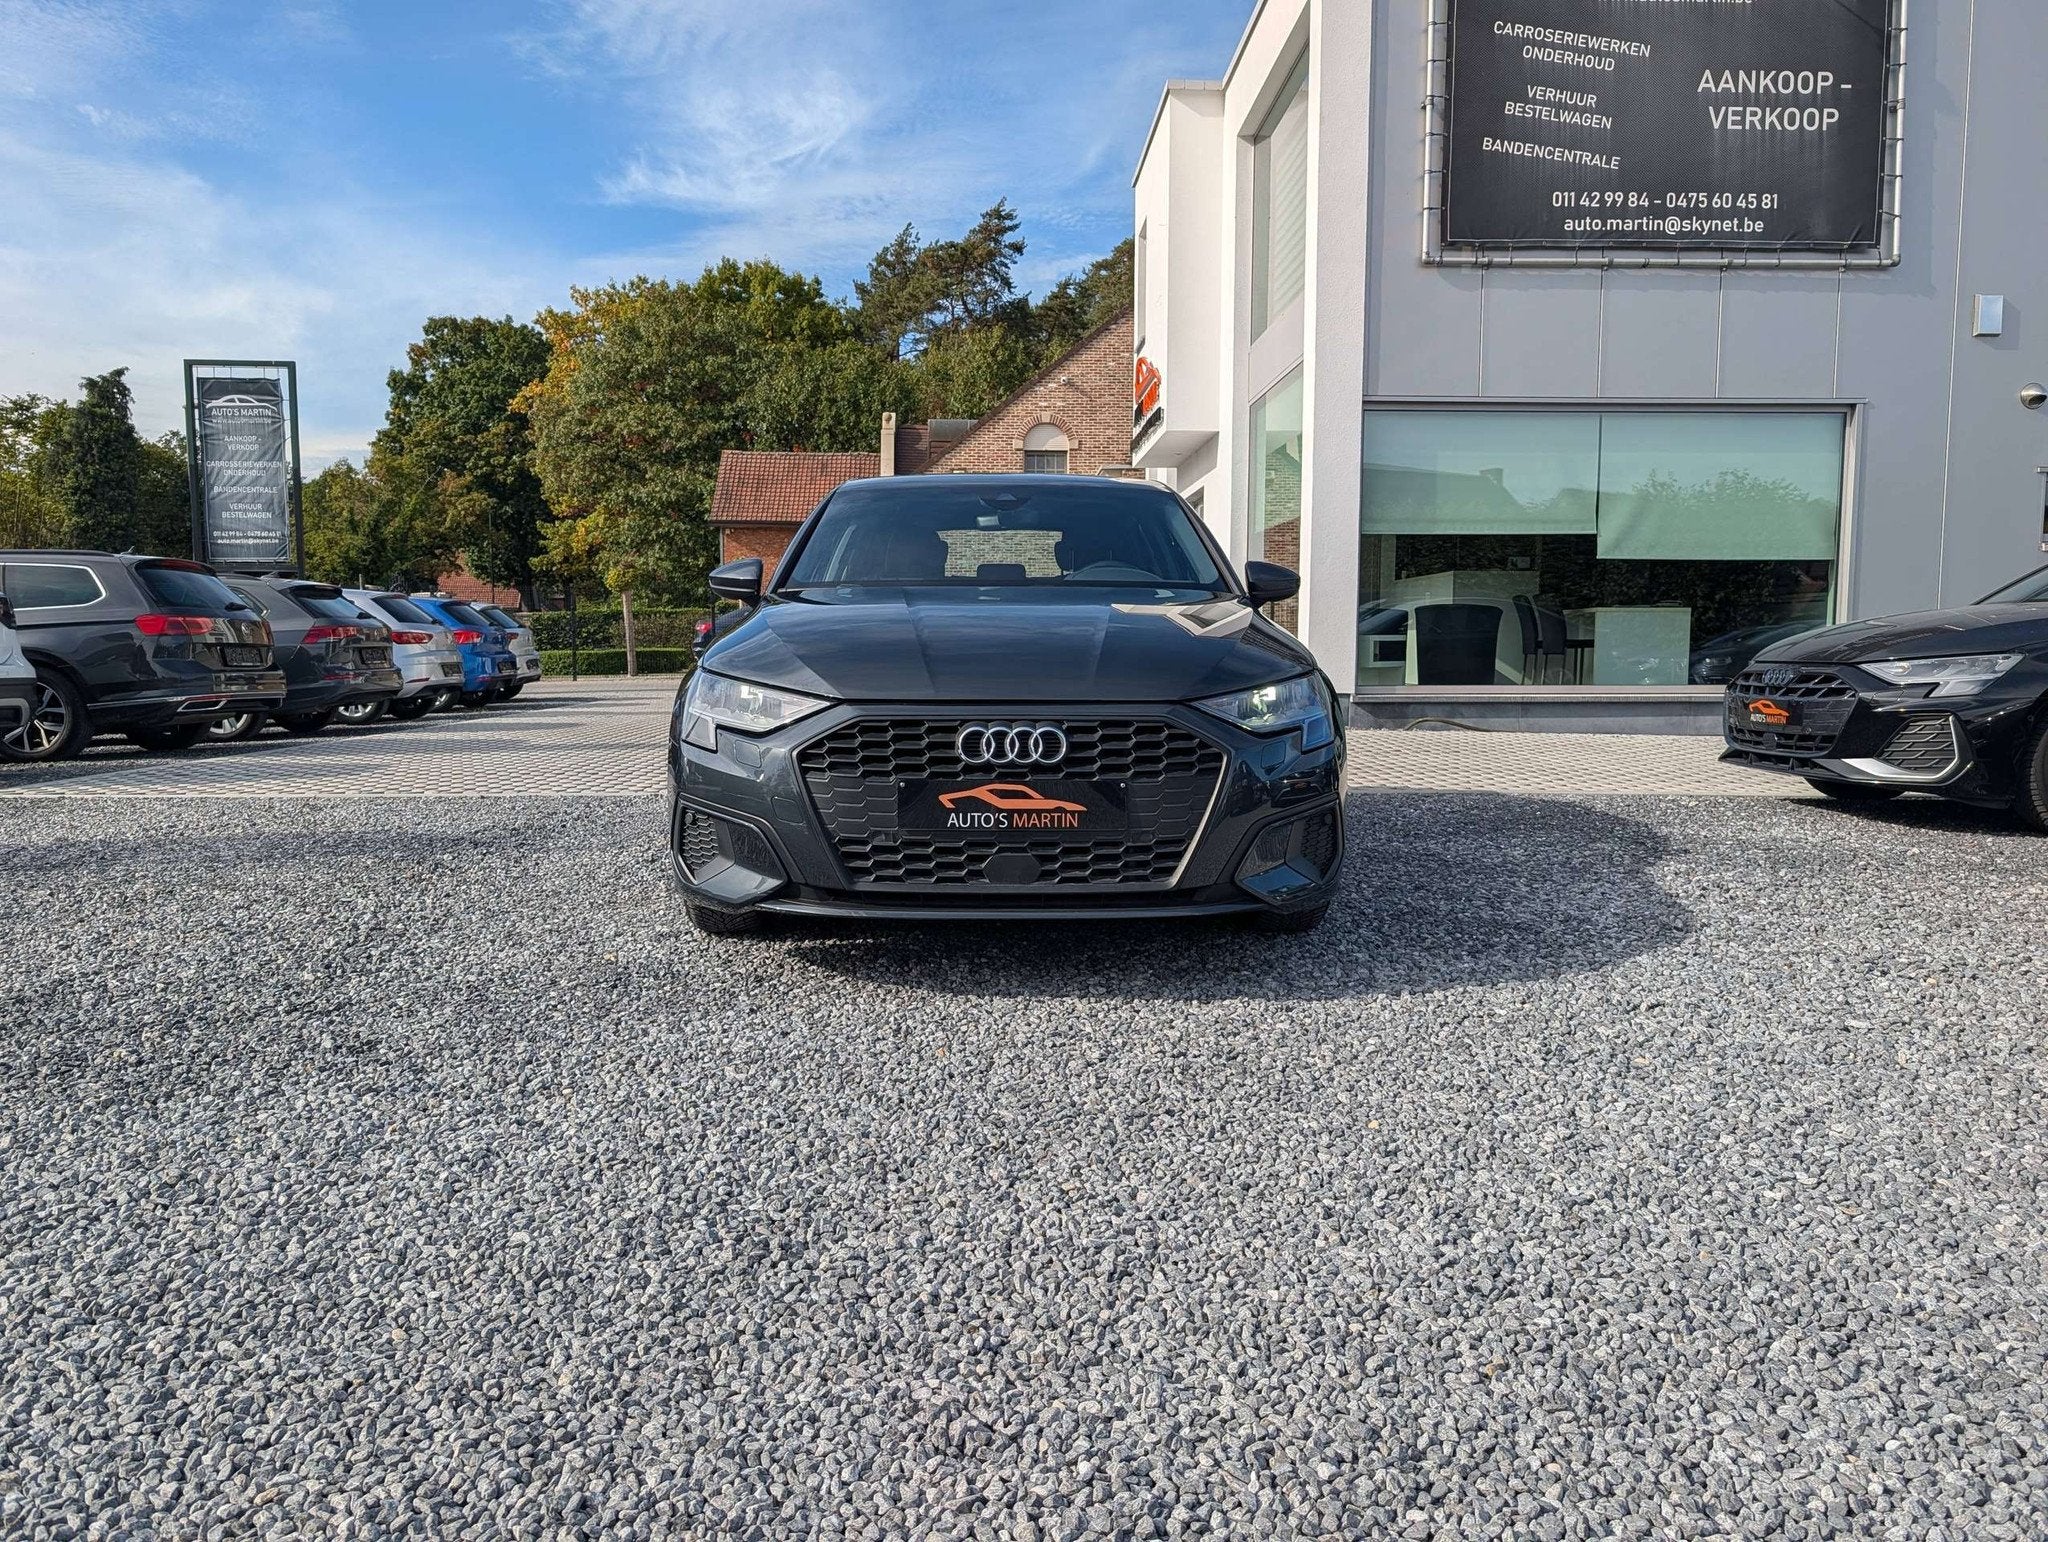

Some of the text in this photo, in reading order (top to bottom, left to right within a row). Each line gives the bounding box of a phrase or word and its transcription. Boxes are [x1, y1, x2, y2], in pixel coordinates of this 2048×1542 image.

[1493, 20, 1651, 57] CARROSERIEWERKEN
[1522, 45, 1616, 71] ONDERHOUD
[1696, 69, 1834, 95] AANKOOP
[1526, 85, 1597, 108] VERHUUR
[1504, 101, 1613, 129] BESTELWAGEN
[1708, 105, 1840, 131] VERKOOP
[1482, 137, 1621, 169] BANDENCENTRALE
[1552, 191, 1575, 207] 011
[1579, 191, 1600, 207] 42
[1604, 192, 1624, 207] 99
[1628, 192, 1649, 208] 84
[1666, 192, 1708, 208] 0475
[1712, 193, 1732, 208] 60
[1736, 193, 1757, 209] 45
[1761, 194, 1778, 209] 81
[1563, 215, 1764, 235] auto.martin@skynet.be
[211, 408, 272, 416] AUTO'S MARTIN
[213, 485, 278, 494] BANDENCENTRALE
[221, 511, 272, 519] BESTELWAGEN
[1766, 715, 1787, 725] MARTIN
[947, 812, 1079, 828] AUTO'S MARTIN
